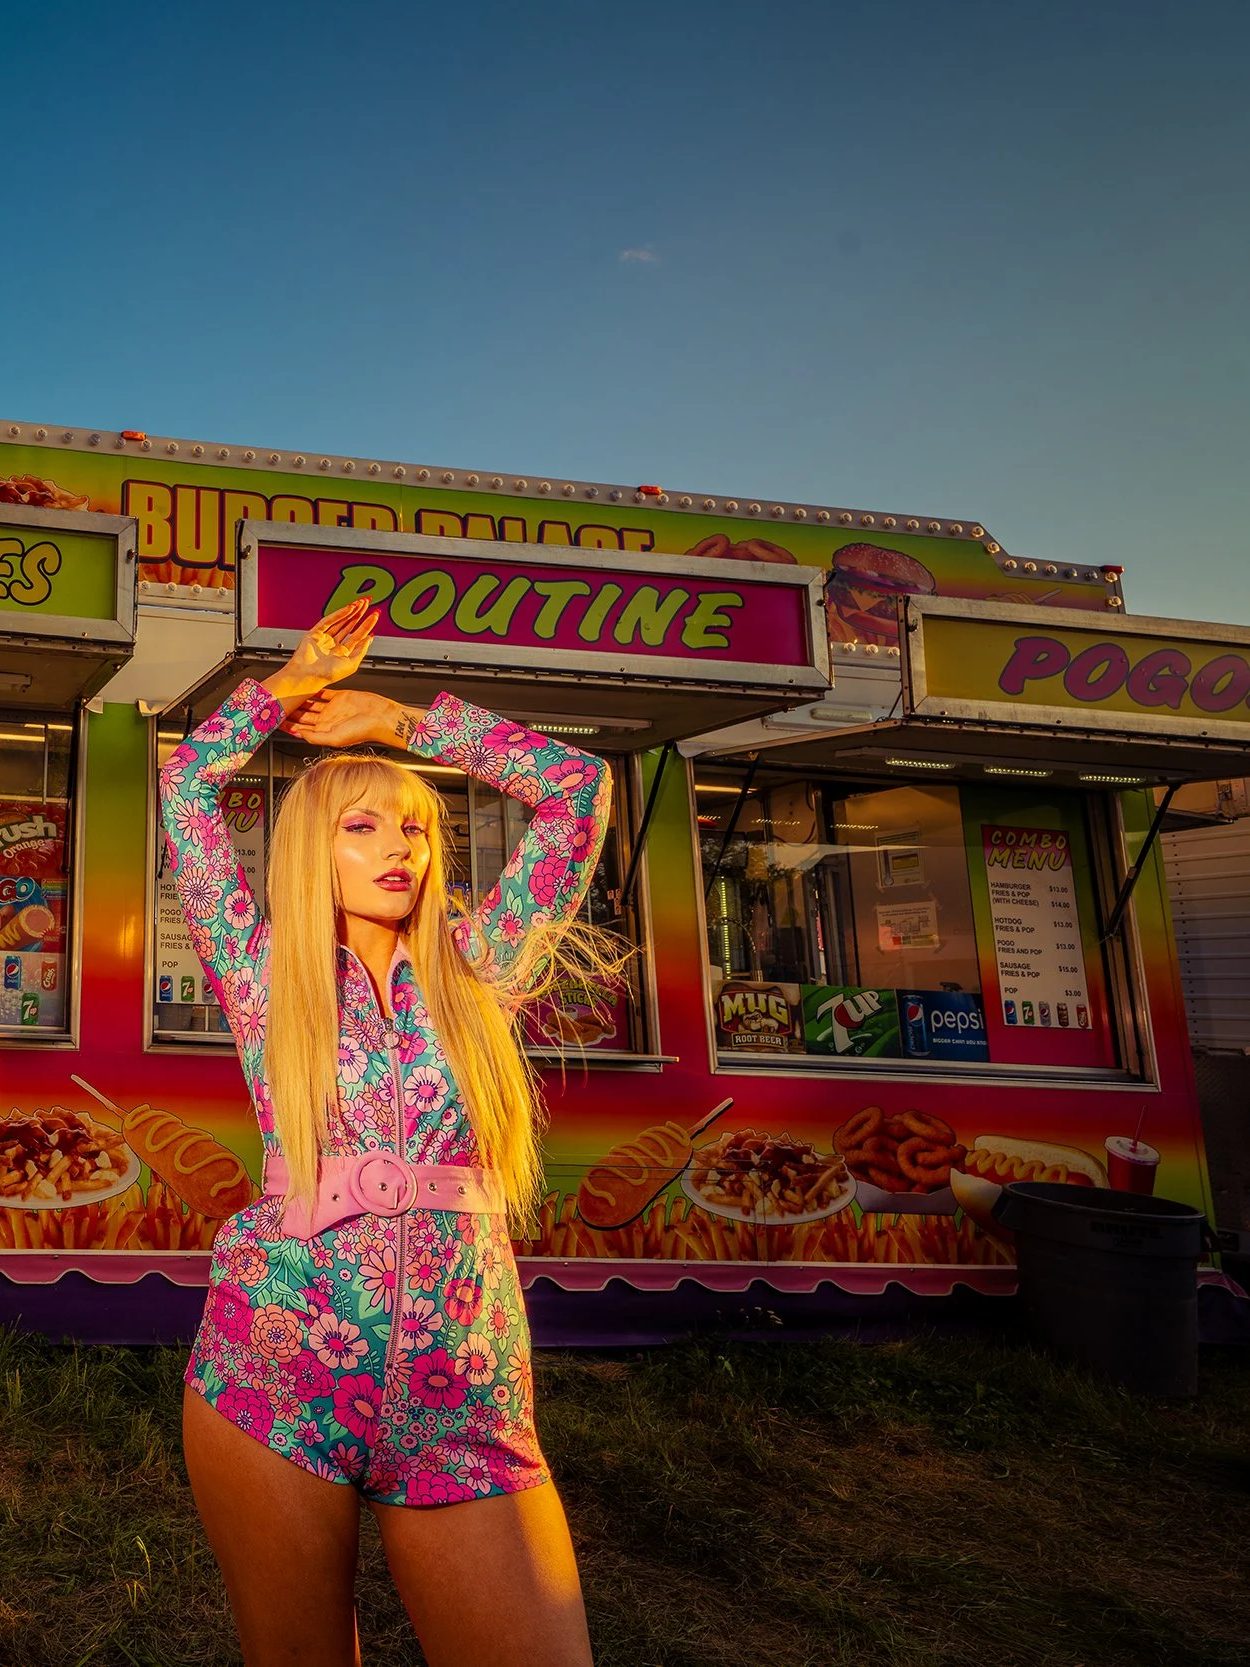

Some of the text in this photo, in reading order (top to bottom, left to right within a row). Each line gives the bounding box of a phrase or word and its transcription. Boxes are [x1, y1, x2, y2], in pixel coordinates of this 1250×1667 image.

[323, 562, 746, 650] POUTINE
[998, 636, 1250, 713] POGO
[990, 830, 1067, 850] COMBO
[3, 839, 46, 859] Orange
[987, 847, 1068, 872] MENU
[990, 882, 1069, 894] HAMBURGER $13.00
[992, 897, 1070, 909] (WITH CHEESE) $14.00
[994, 917, 1073, 929] HOTDOG $13.00
[995, 925, 1015, 933] FRIES
[160, 933, 192, 941] SAUSAG
[160, 942, 184, 950] FRIES
[999, 961, 1078, 973] SAUSAGE $15.00
[1065, 989, 1082, 997] $3.00
[720, 993, 790, 1026] MUG
[816, 991, 883, 1053] 7UP
[930, 1009, 984, 1034] pepsi
[735, 1035, 782, 1045] ROOT BEER
